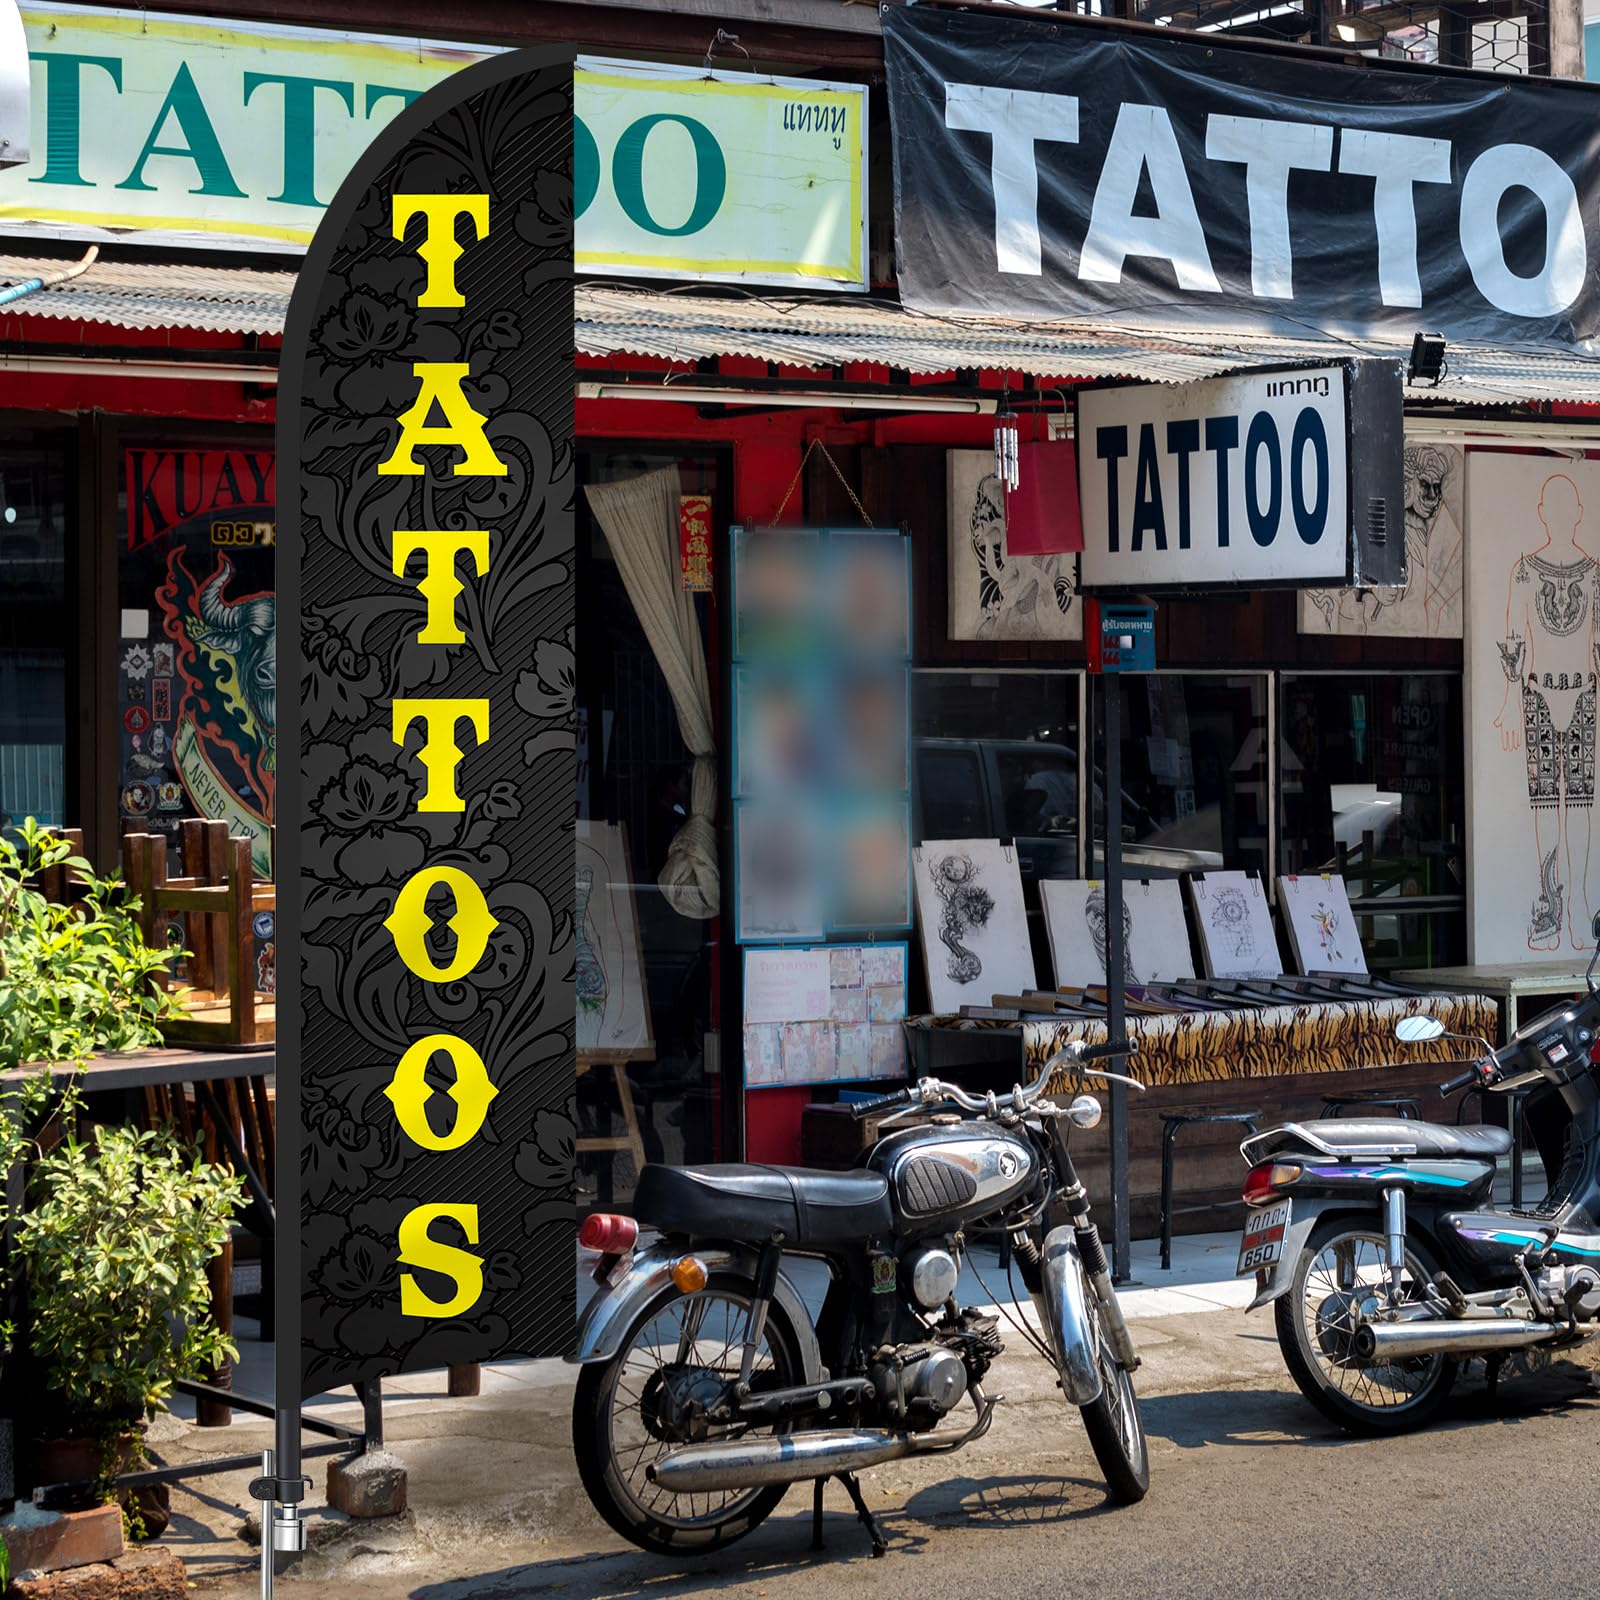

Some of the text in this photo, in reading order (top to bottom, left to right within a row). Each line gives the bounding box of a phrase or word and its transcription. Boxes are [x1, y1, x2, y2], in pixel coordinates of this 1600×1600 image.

[28, 51, 727, 237] TATO
[1096, 406, 1330, 553] TATTOO
[189, 762, 226, 820] NEVER
[377, 194, 509, 1319] TATTOOS
[1244, 1244, 1274, 1267] 650
